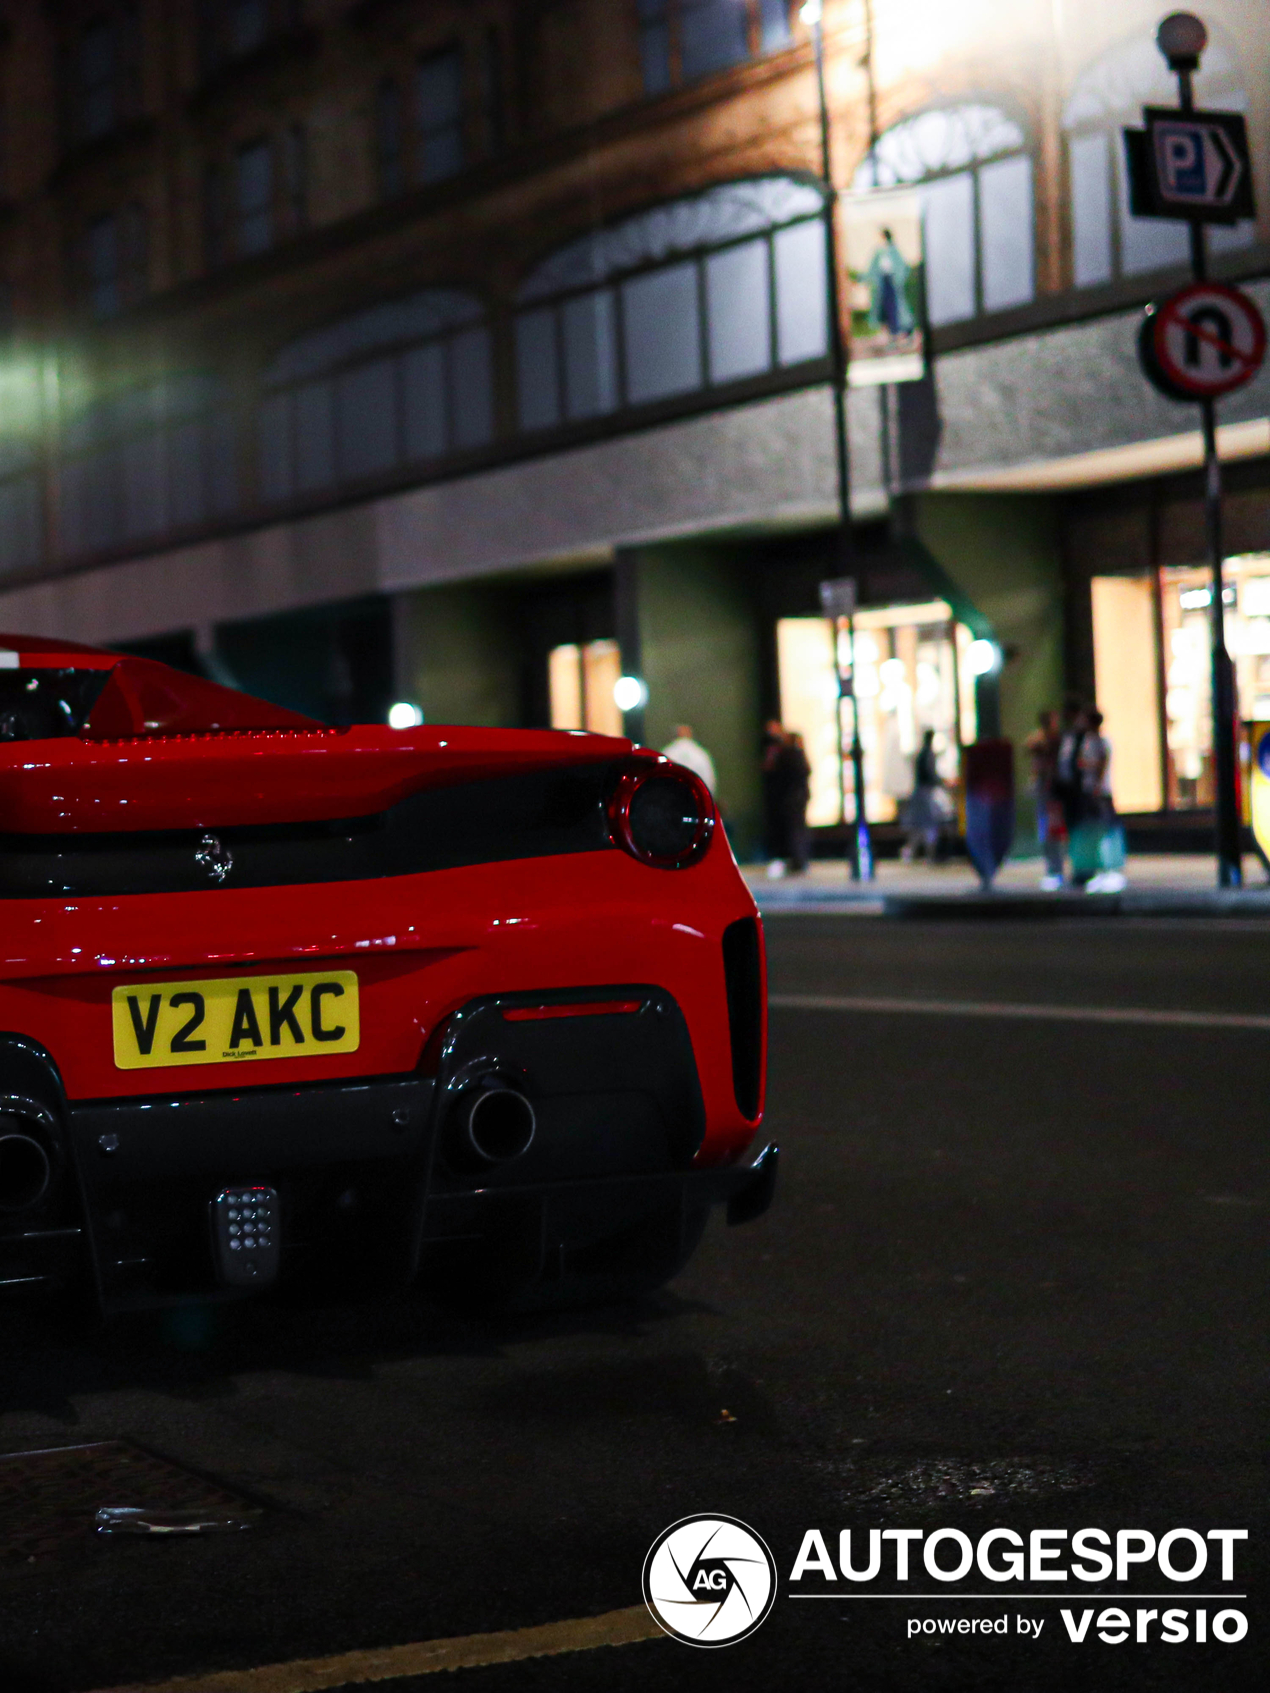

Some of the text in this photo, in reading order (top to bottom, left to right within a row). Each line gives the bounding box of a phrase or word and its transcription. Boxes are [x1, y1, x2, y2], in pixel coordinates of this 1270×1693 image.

[1166, 136, 1195, 188] P
[126, 982, 346, 1055] V2 AKC
